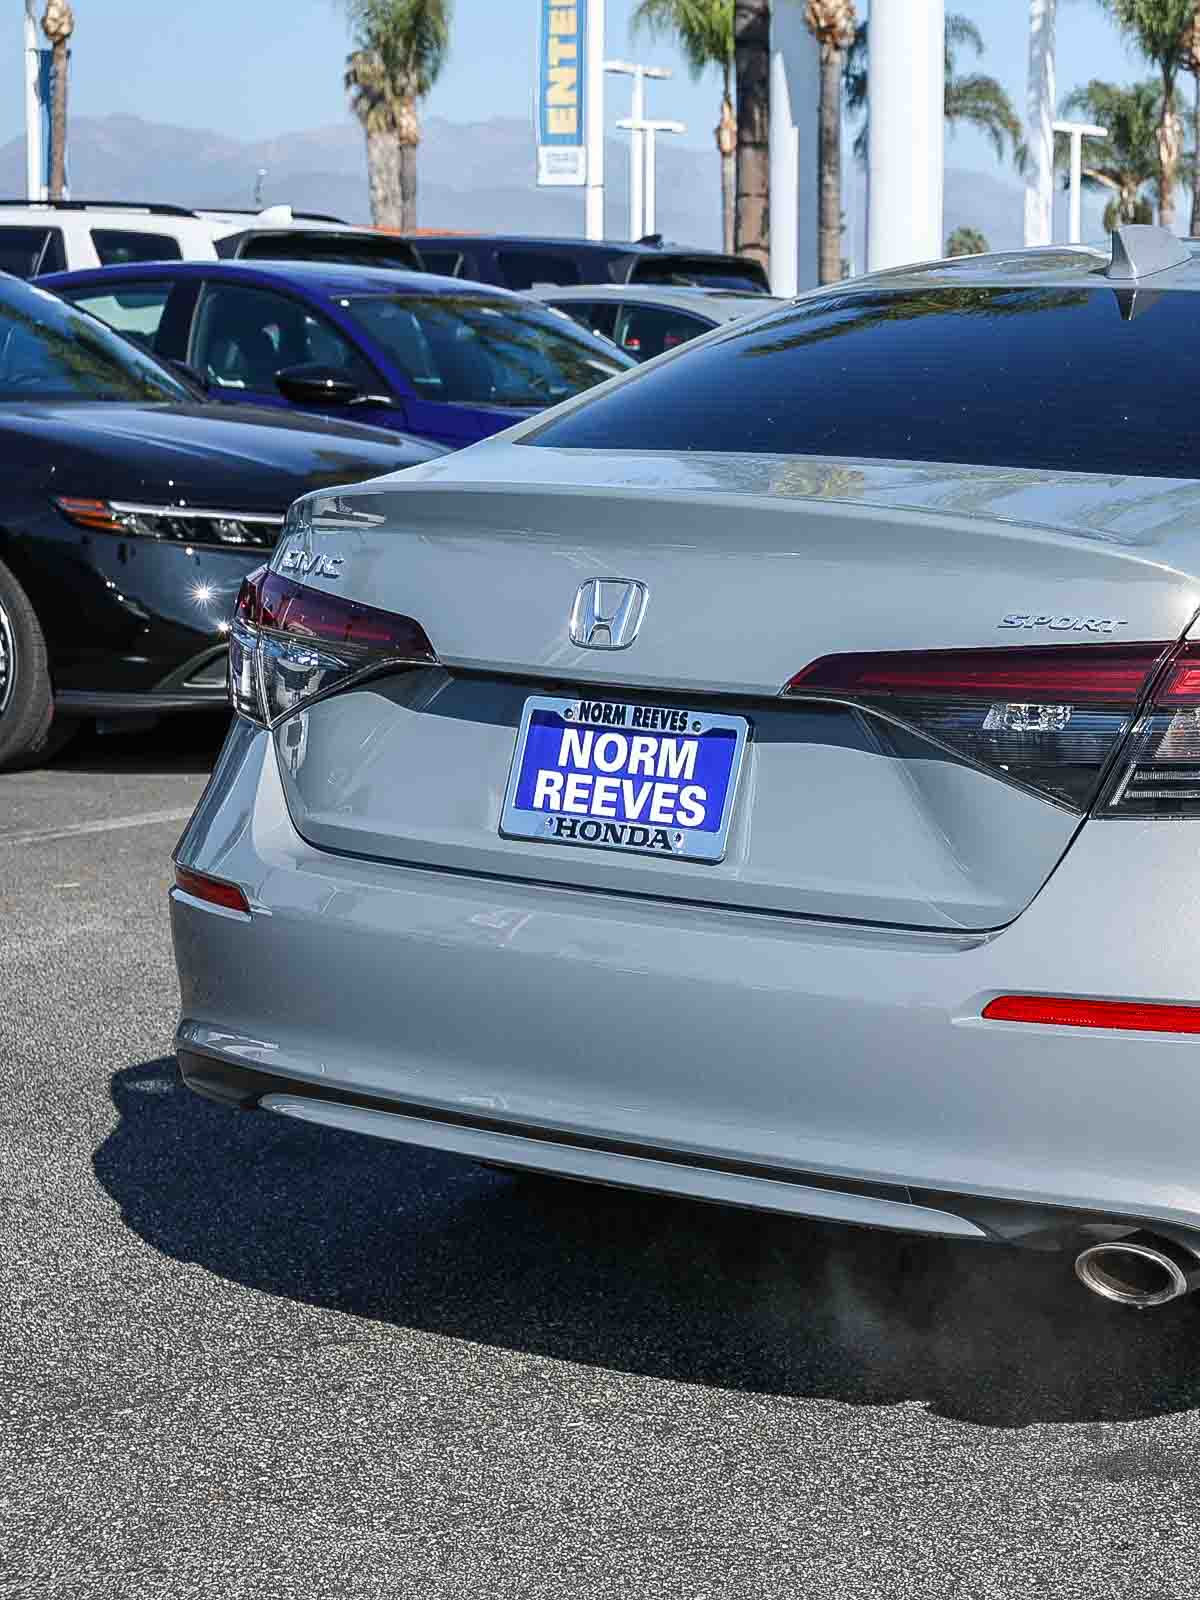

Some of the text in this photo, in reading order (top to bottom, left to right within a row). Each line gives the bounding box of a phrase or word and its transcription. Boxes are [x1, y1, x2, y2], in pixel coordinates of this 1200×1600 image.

[547, 0, 577, 134] ENTE
[997, 614, 1128, 634] SPORT
[578, 702, 688, 732] NORM REEVES
[557, 728, 699, 780] NORM
[532, 769, 707, 827] REEVES
[553, 816, 673, 850] HONDA
